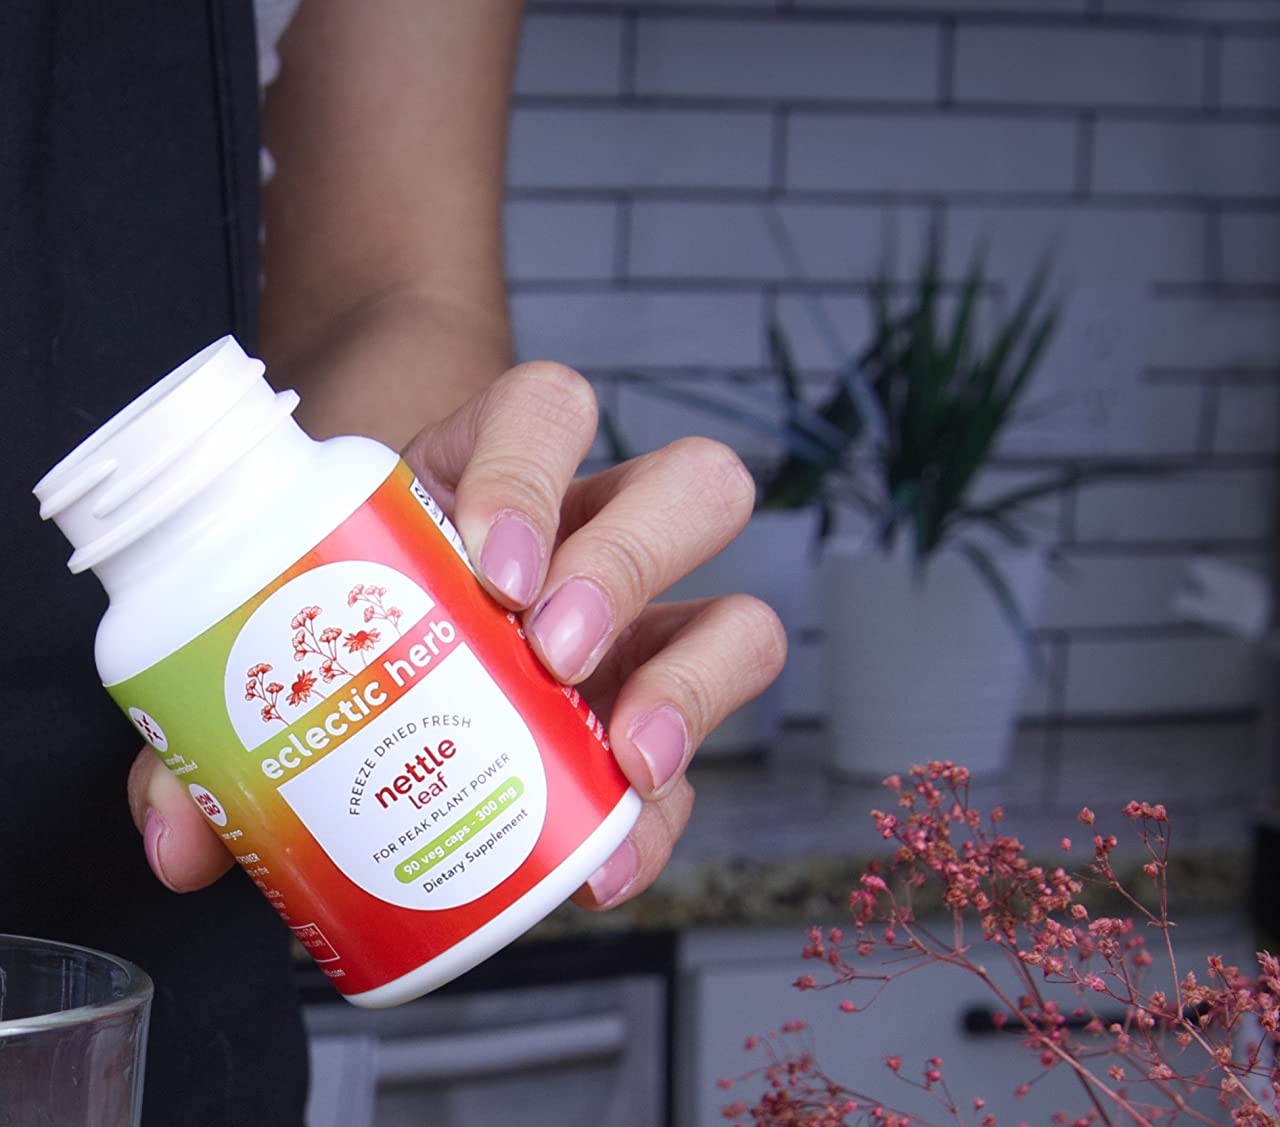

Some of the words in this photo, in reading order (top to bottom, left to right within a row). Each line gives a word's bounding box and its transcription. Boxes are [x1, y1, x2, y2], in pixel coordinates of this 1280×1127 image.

[261, 681, 387, 779] eclectic
[383, 619, 456, 687] herb
[349, 758, 376, 816] FREEZE
[374, 722, 418, 758] DRIED
[422, 714, 472, 729] FRESH
[372, 842, 399, 864] FOR
[398, 819, 431, 846] PEAK
[431, 787, 470, 822] PLANT
[469, 752, 511, 791] POWER
[374, 739, 457, 810] nettle
[408, 772, 449, 810] leaf
[403, 859, 421, 876] 90
[420, 841, 445, 864] veg
[443, 824, 471, 849] caps
[475, 801, 499, 821] 300
[497, 785, 517, 808] mg
[422, 860, 467, 894] Dietary
[465, 809, 529, 864] Supplement
